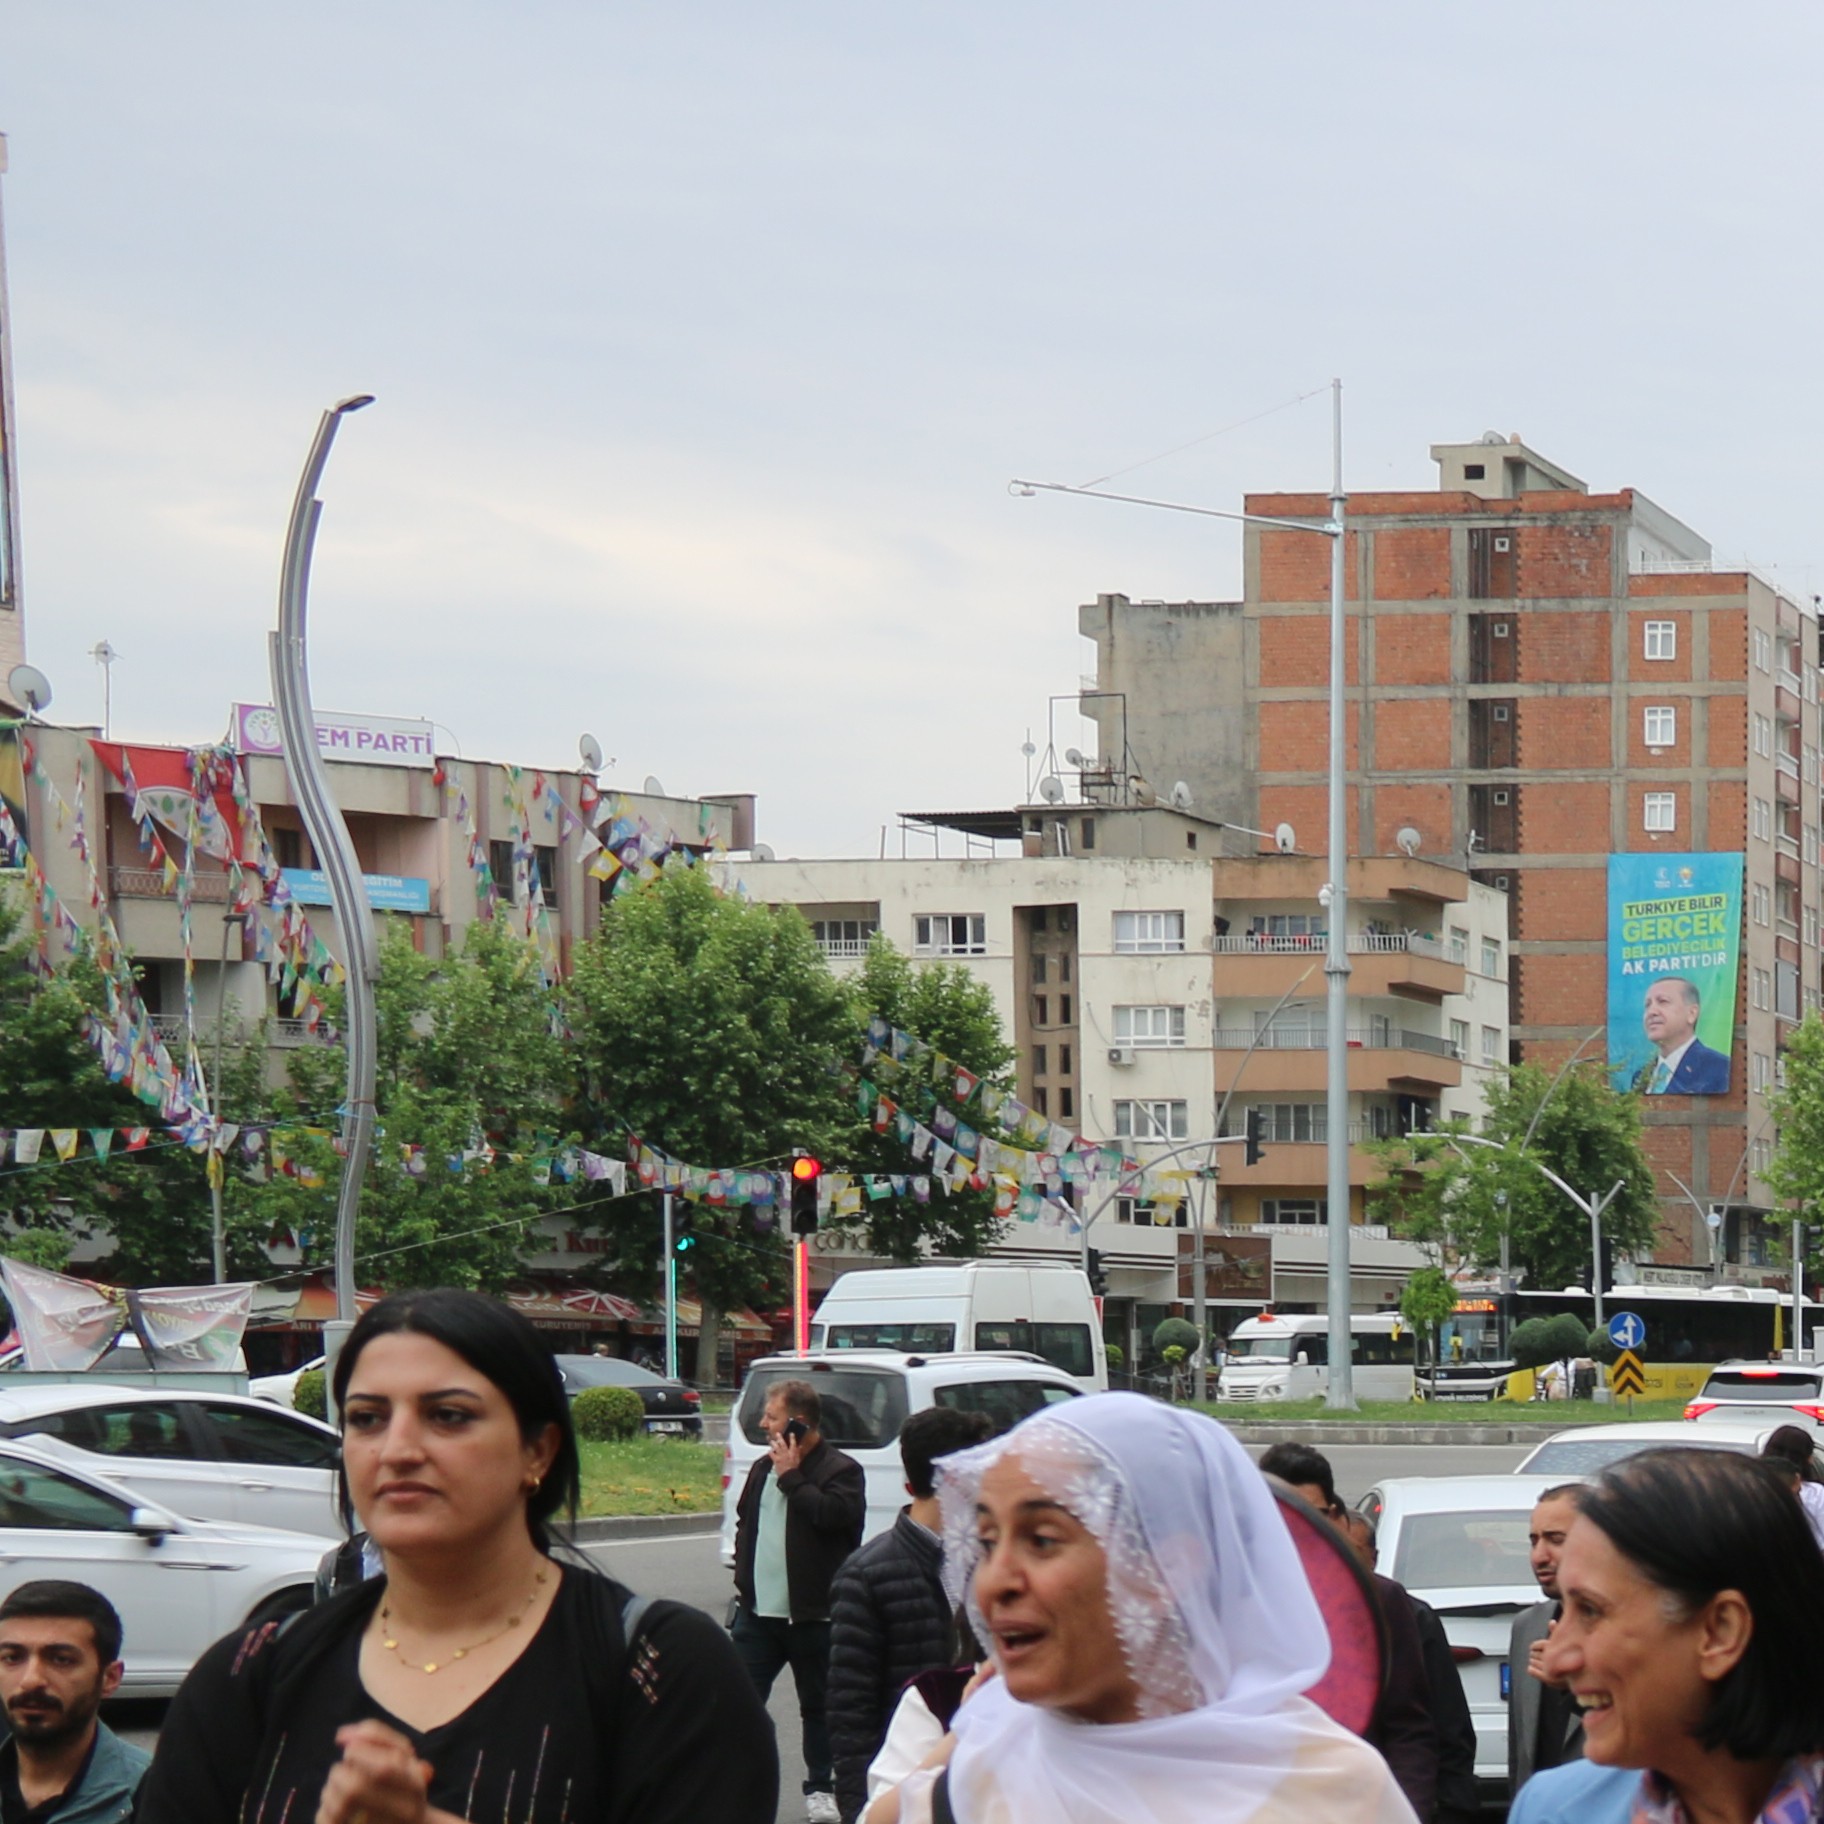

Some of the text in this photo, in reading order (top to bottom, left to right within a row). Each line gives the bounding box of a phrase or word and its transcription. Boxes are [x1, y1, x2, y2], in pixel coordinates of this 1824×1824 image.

[357, 731, 432, 755] PARTİ
[1623, 912, 1726, 942] GERÇEK
[1622, 961, 1645, 975] AK
